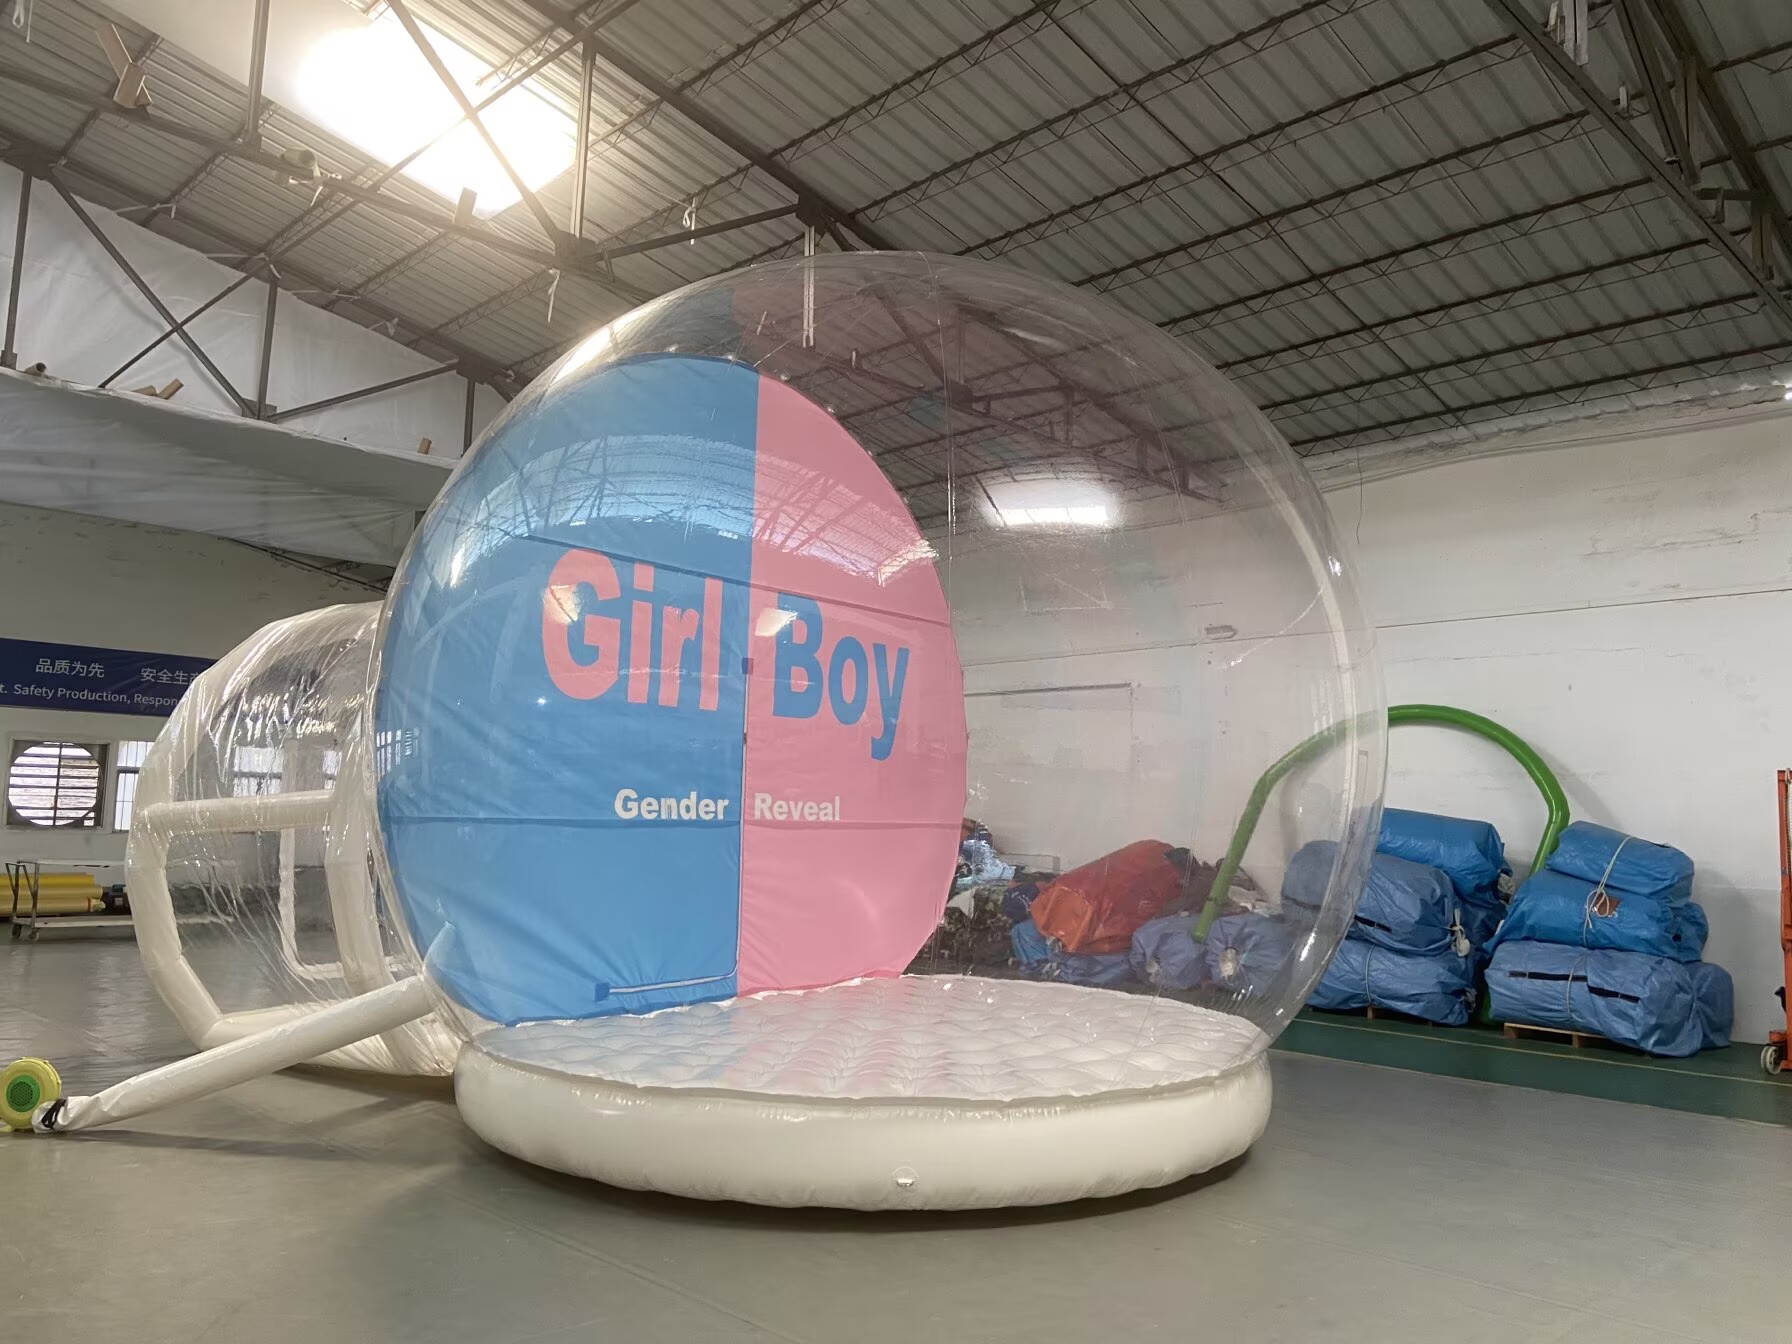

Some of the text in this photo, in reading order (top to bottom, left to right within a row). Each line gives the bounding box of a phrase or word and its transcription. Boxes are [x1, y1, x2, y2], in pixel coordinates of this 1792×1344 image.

[35, 658, 105, 678] 品质为先
[542, 548, 910, 761] Girl Boy
[13, 684, 55, 700] Safety
[57, 687, 131, 705] Production,
[614, 788, 841, 821] Gender Reveal
